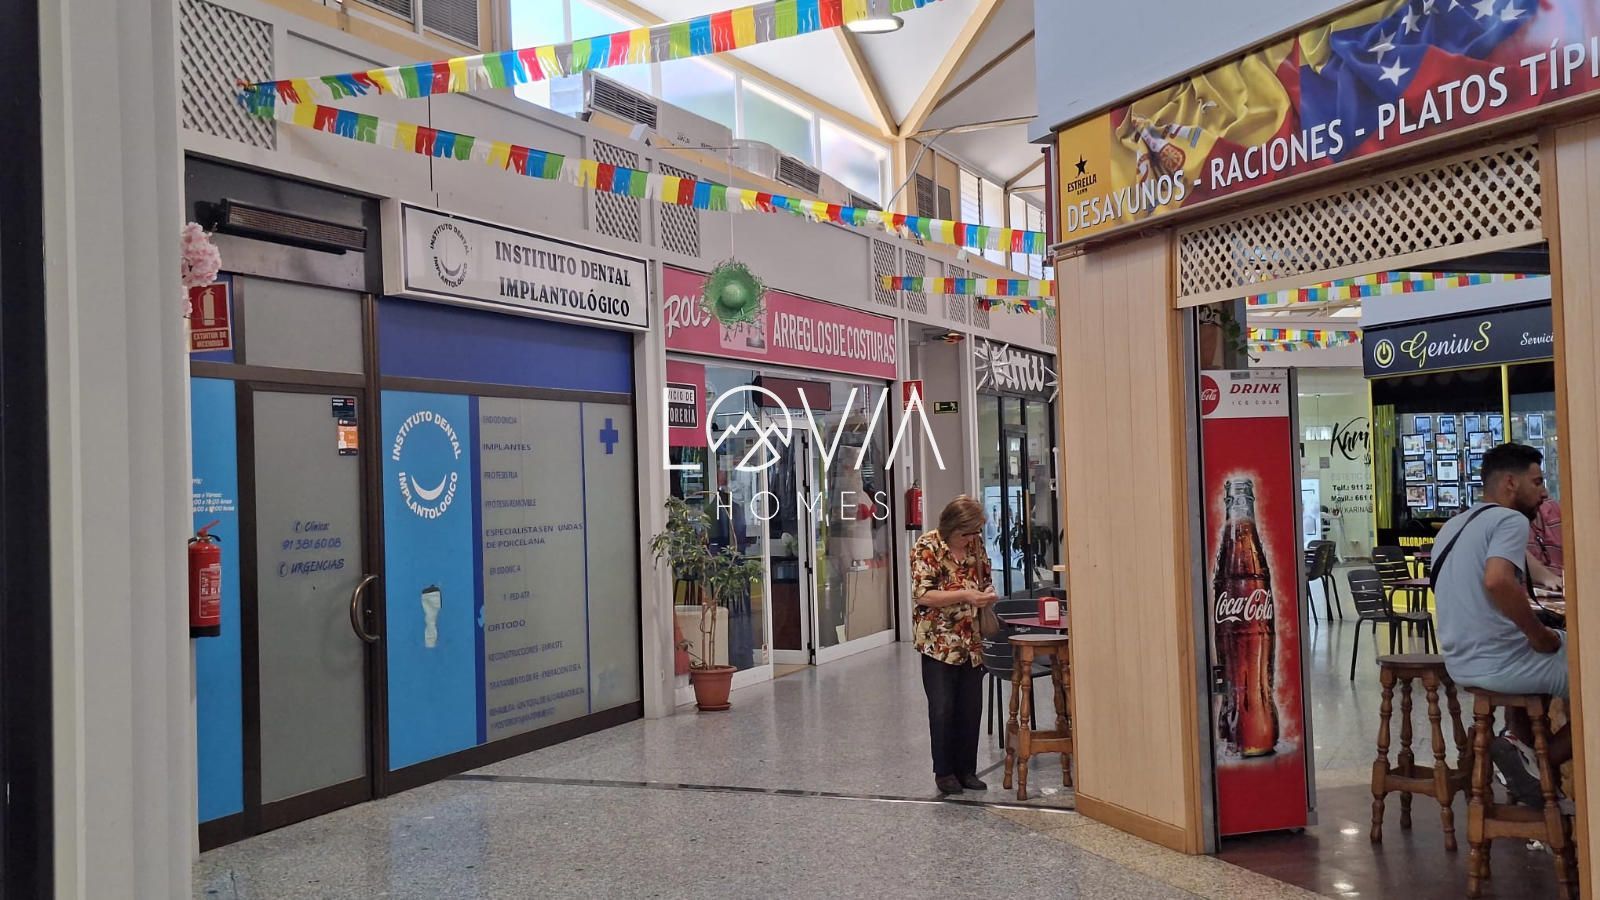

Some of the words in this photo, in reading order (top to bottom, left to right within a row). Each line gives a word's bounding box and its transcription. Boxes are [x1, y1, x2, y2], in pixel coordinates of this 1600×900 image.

[1067, 169, 1185, 233] DESAYUNOS
[1210, 118, 1344, 190] RACIONES
[1377, 65, 1508, 142] PLATOS
[1067, 173, 1097, 192] ESTRELLA
[429, 223, 452, 249] INSTITUTO
[453, 226, 470, 255] DENTAL
[494, 240, 577, 275] INSTITUTO
[580, 259, 631, 287] DENTAL
[499, 275, 630, 318] IMPLANTOLÓGICO
[772, 311, 832, 356] ARREGLOS
[832, 322, 847, 357] DE
[847, 325, 896, 365] COSTURAS
[685, 392, 694, 402] DE
[1229, 383, 1282, 394] DRINK
[669, 406, 696, 424] ORERÍA
[392, 411, 433, 461] INSTITUTO
[434, 414, 462, 460] DENTAL
[1330, 417, 1370, 461] Kari
[483, 443, 532, 452] IMPLANTES
[398, 472, 458, 519] IMPLANTOLOGICO
[485, 526, 543, 537] ESPECIALISTAS
[543, 525, 554, 533] EN
[486, 541, 497, 550] DE
[498, 538, 546, 548] PORCELANA
[1398, 536, 1435, 547] VALORACIO
[291, 558, 345, 576] URGENCIAS
[1215, 588, 1274, 624] Coca-Cola
[487, 619, 526, 632] ORTODO
